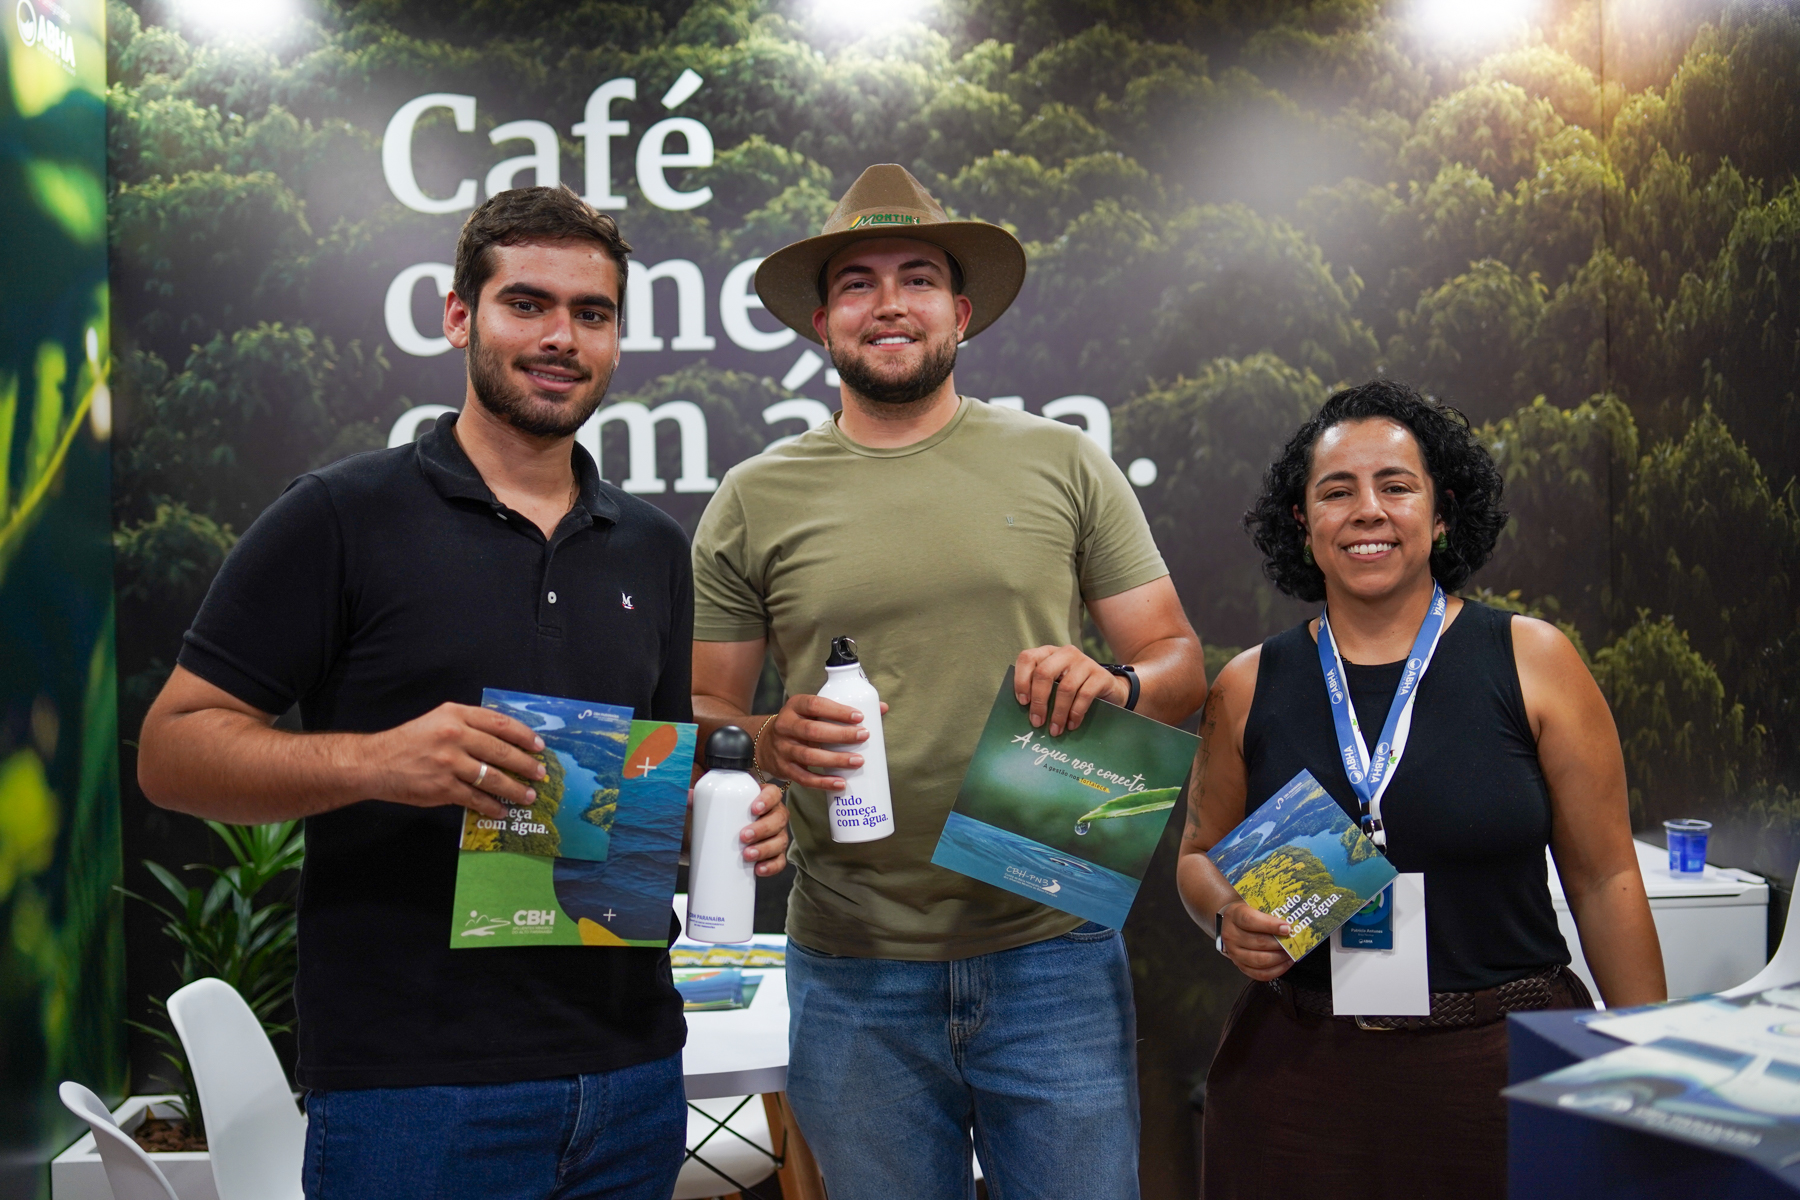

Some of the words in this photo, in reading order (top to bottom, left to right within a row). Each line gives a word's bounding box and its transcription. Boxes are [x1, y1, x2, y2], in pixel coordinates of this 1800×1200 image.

[37, 14, 76, 68] ABHA
[382, 68, 715, 214] Café
[1432, 596, 1447, 617] ABHA
[1326, 668, 1339, 693] ABHA
[1400, 670, 1416, 696] ABHA
[1011, 731, 1034, 750] A
[1031, 735, 1070, 766] água
[1071, 758, 1095, 776] nos
[1096, 768, 1149, 793] conecta
[1344, 745, 1358, 770] ABHA
[1370, 756, 1386, 784] ABHA
[834, 795, 863, 806] Tudo
[836, 806, 877, 817] começa
[477, 819, 507, 831] com
[510, 818, 549, 836] água.
[837, 819, 860, 827] com
[862, 814, 889, 828] água.
[513, 909, 556, 926] CBH
[1271, 894, 1301, 919] Tudo
[1286, 893, 1321, 924] omeça
[1289, 916, 1313, 938] com
[1312, 893, 1342, 918] água.
